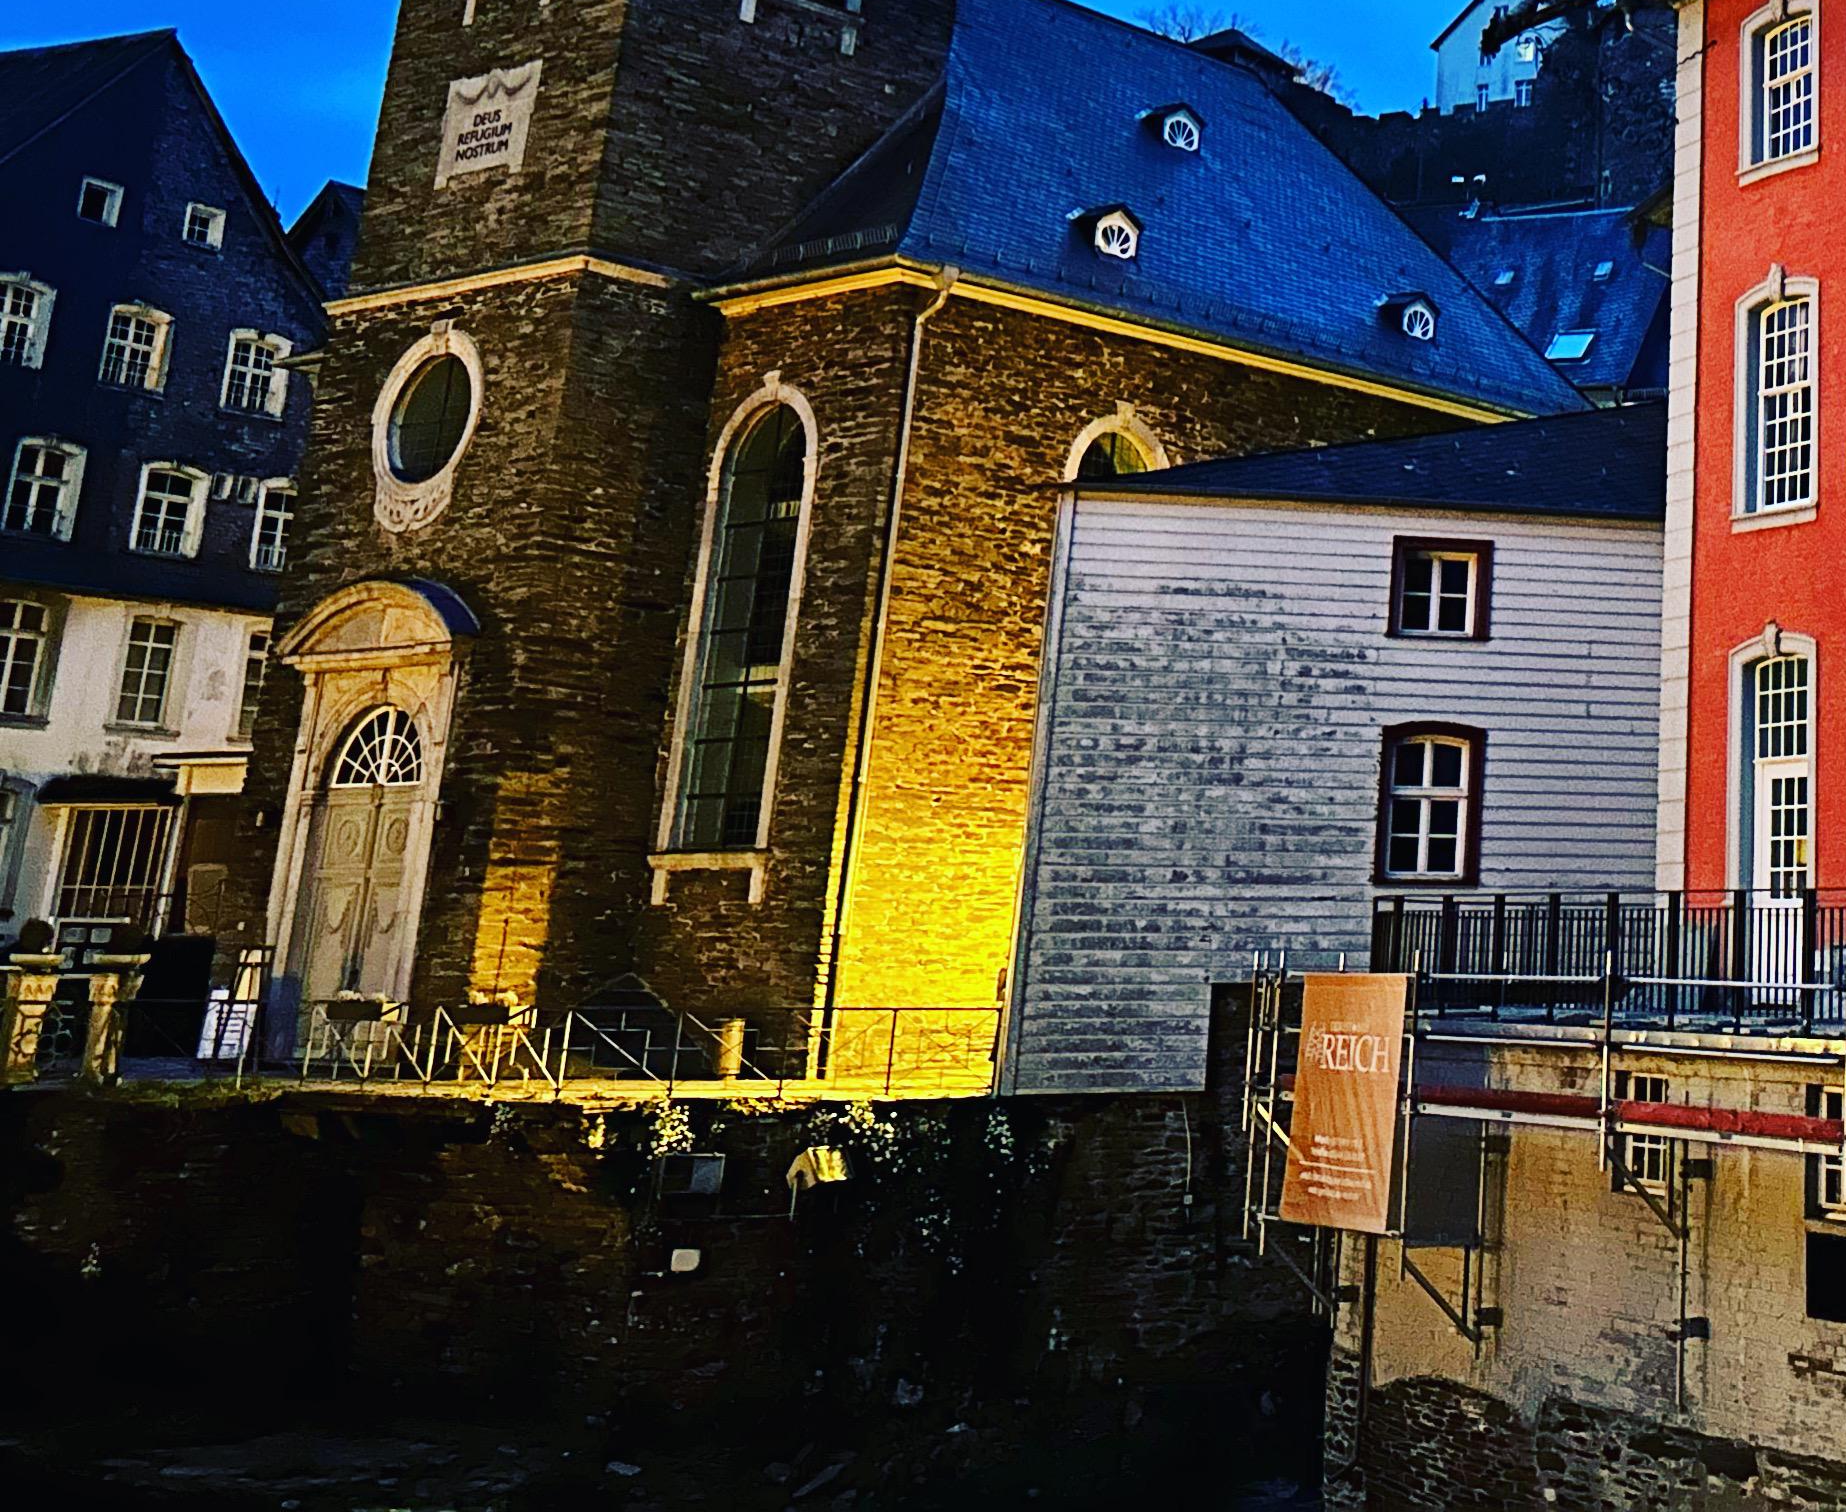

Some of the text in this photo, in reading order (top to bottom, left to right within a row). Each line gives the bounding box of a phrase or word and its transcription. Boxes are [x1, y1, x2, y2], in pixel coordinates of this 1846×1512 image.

[473, 109, 502, 127] DEUS
[457, 122, 512, 146] REFUGIUM
[455, 138, 509, 162] NOSTRUM
[1319, 1033, 1391, 1073] REICH
